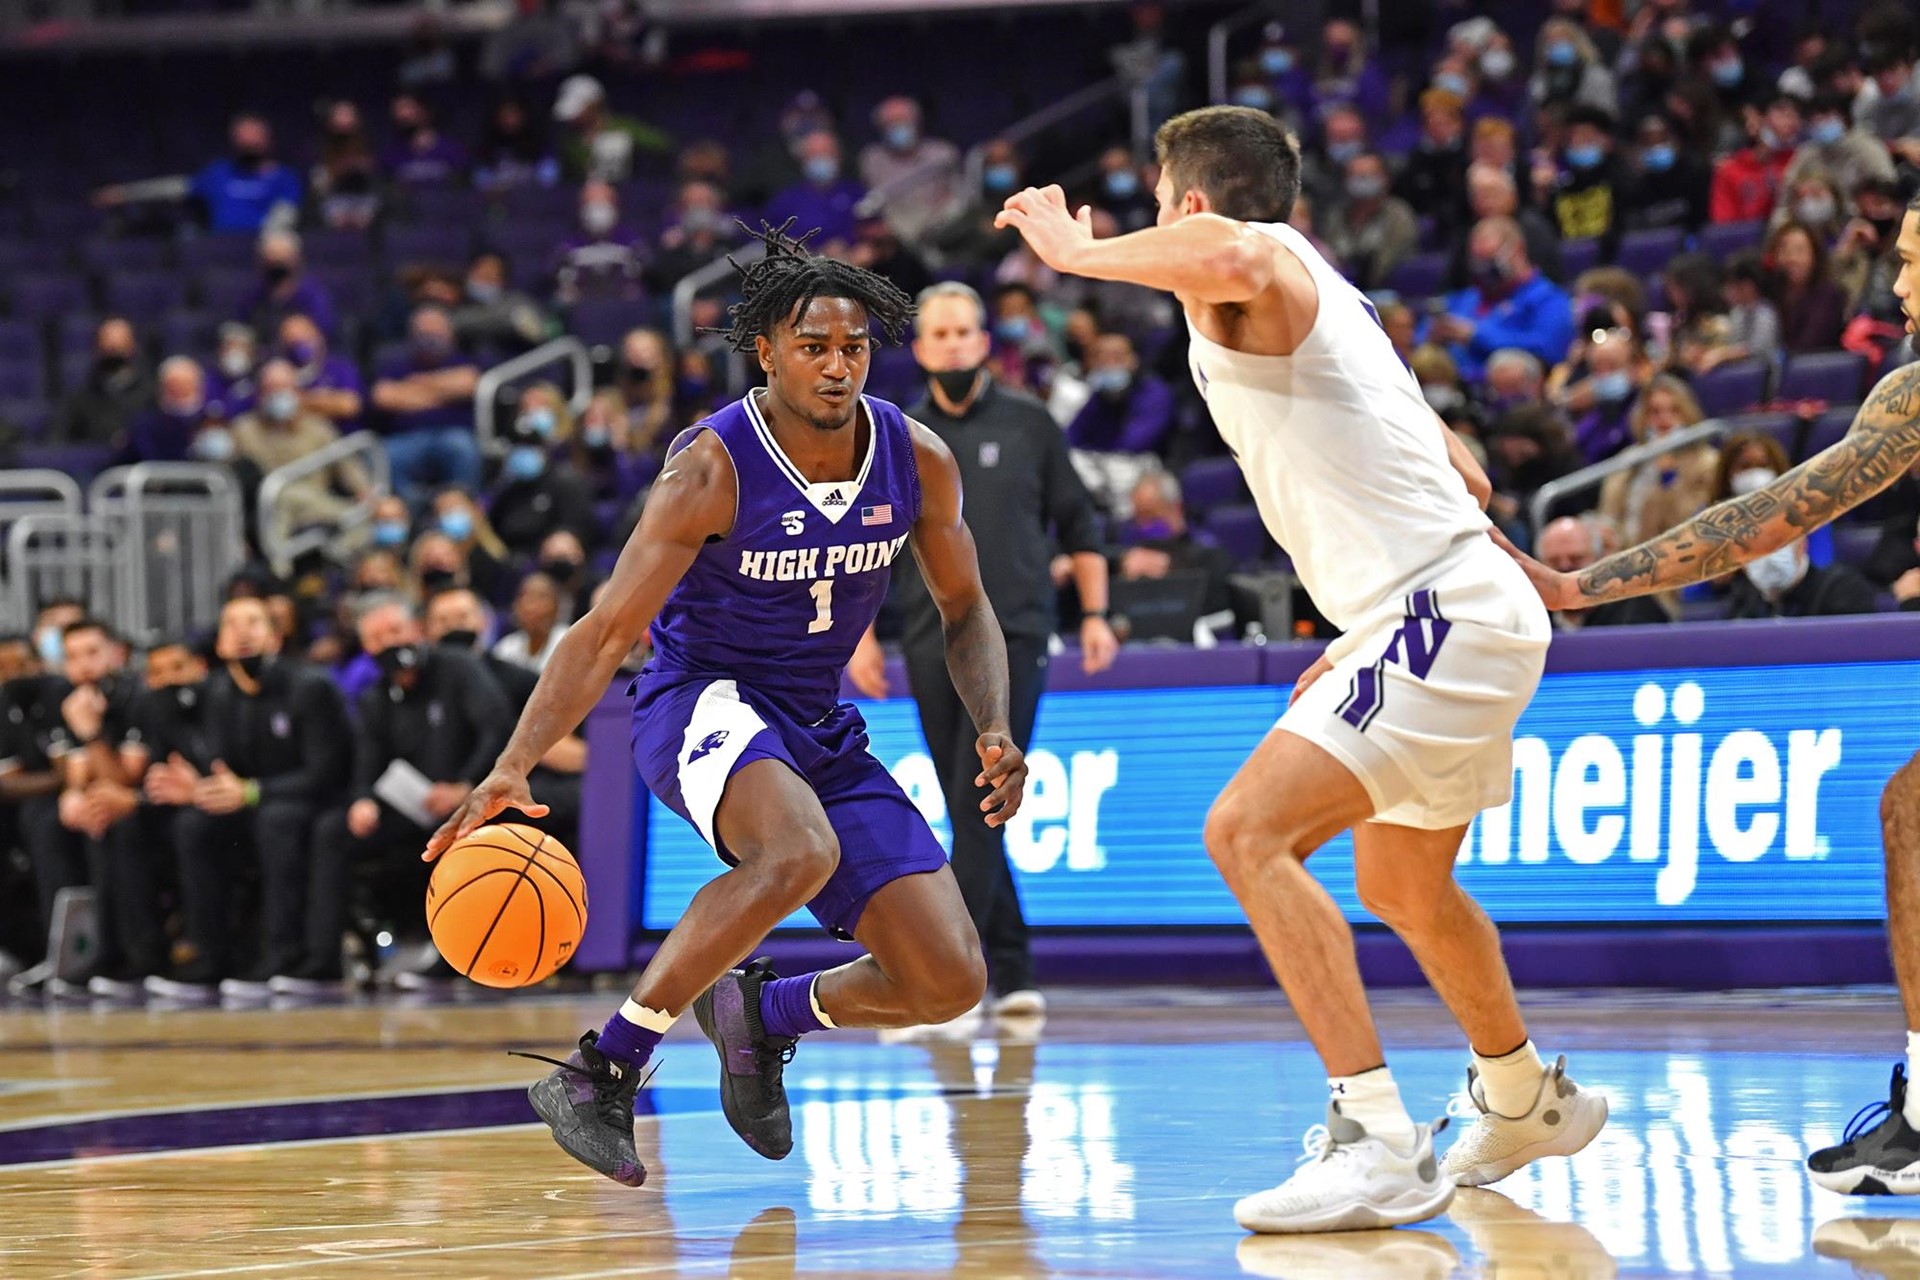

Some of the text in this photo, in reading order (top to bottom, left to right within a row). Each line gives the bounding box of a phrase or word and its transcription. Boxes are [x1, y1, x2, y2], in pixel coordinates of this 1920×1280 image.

[821, 498, 848, 507] adidas
[739, 547, 819, 581] HIGH
[808, 580, 834, 634] 1
